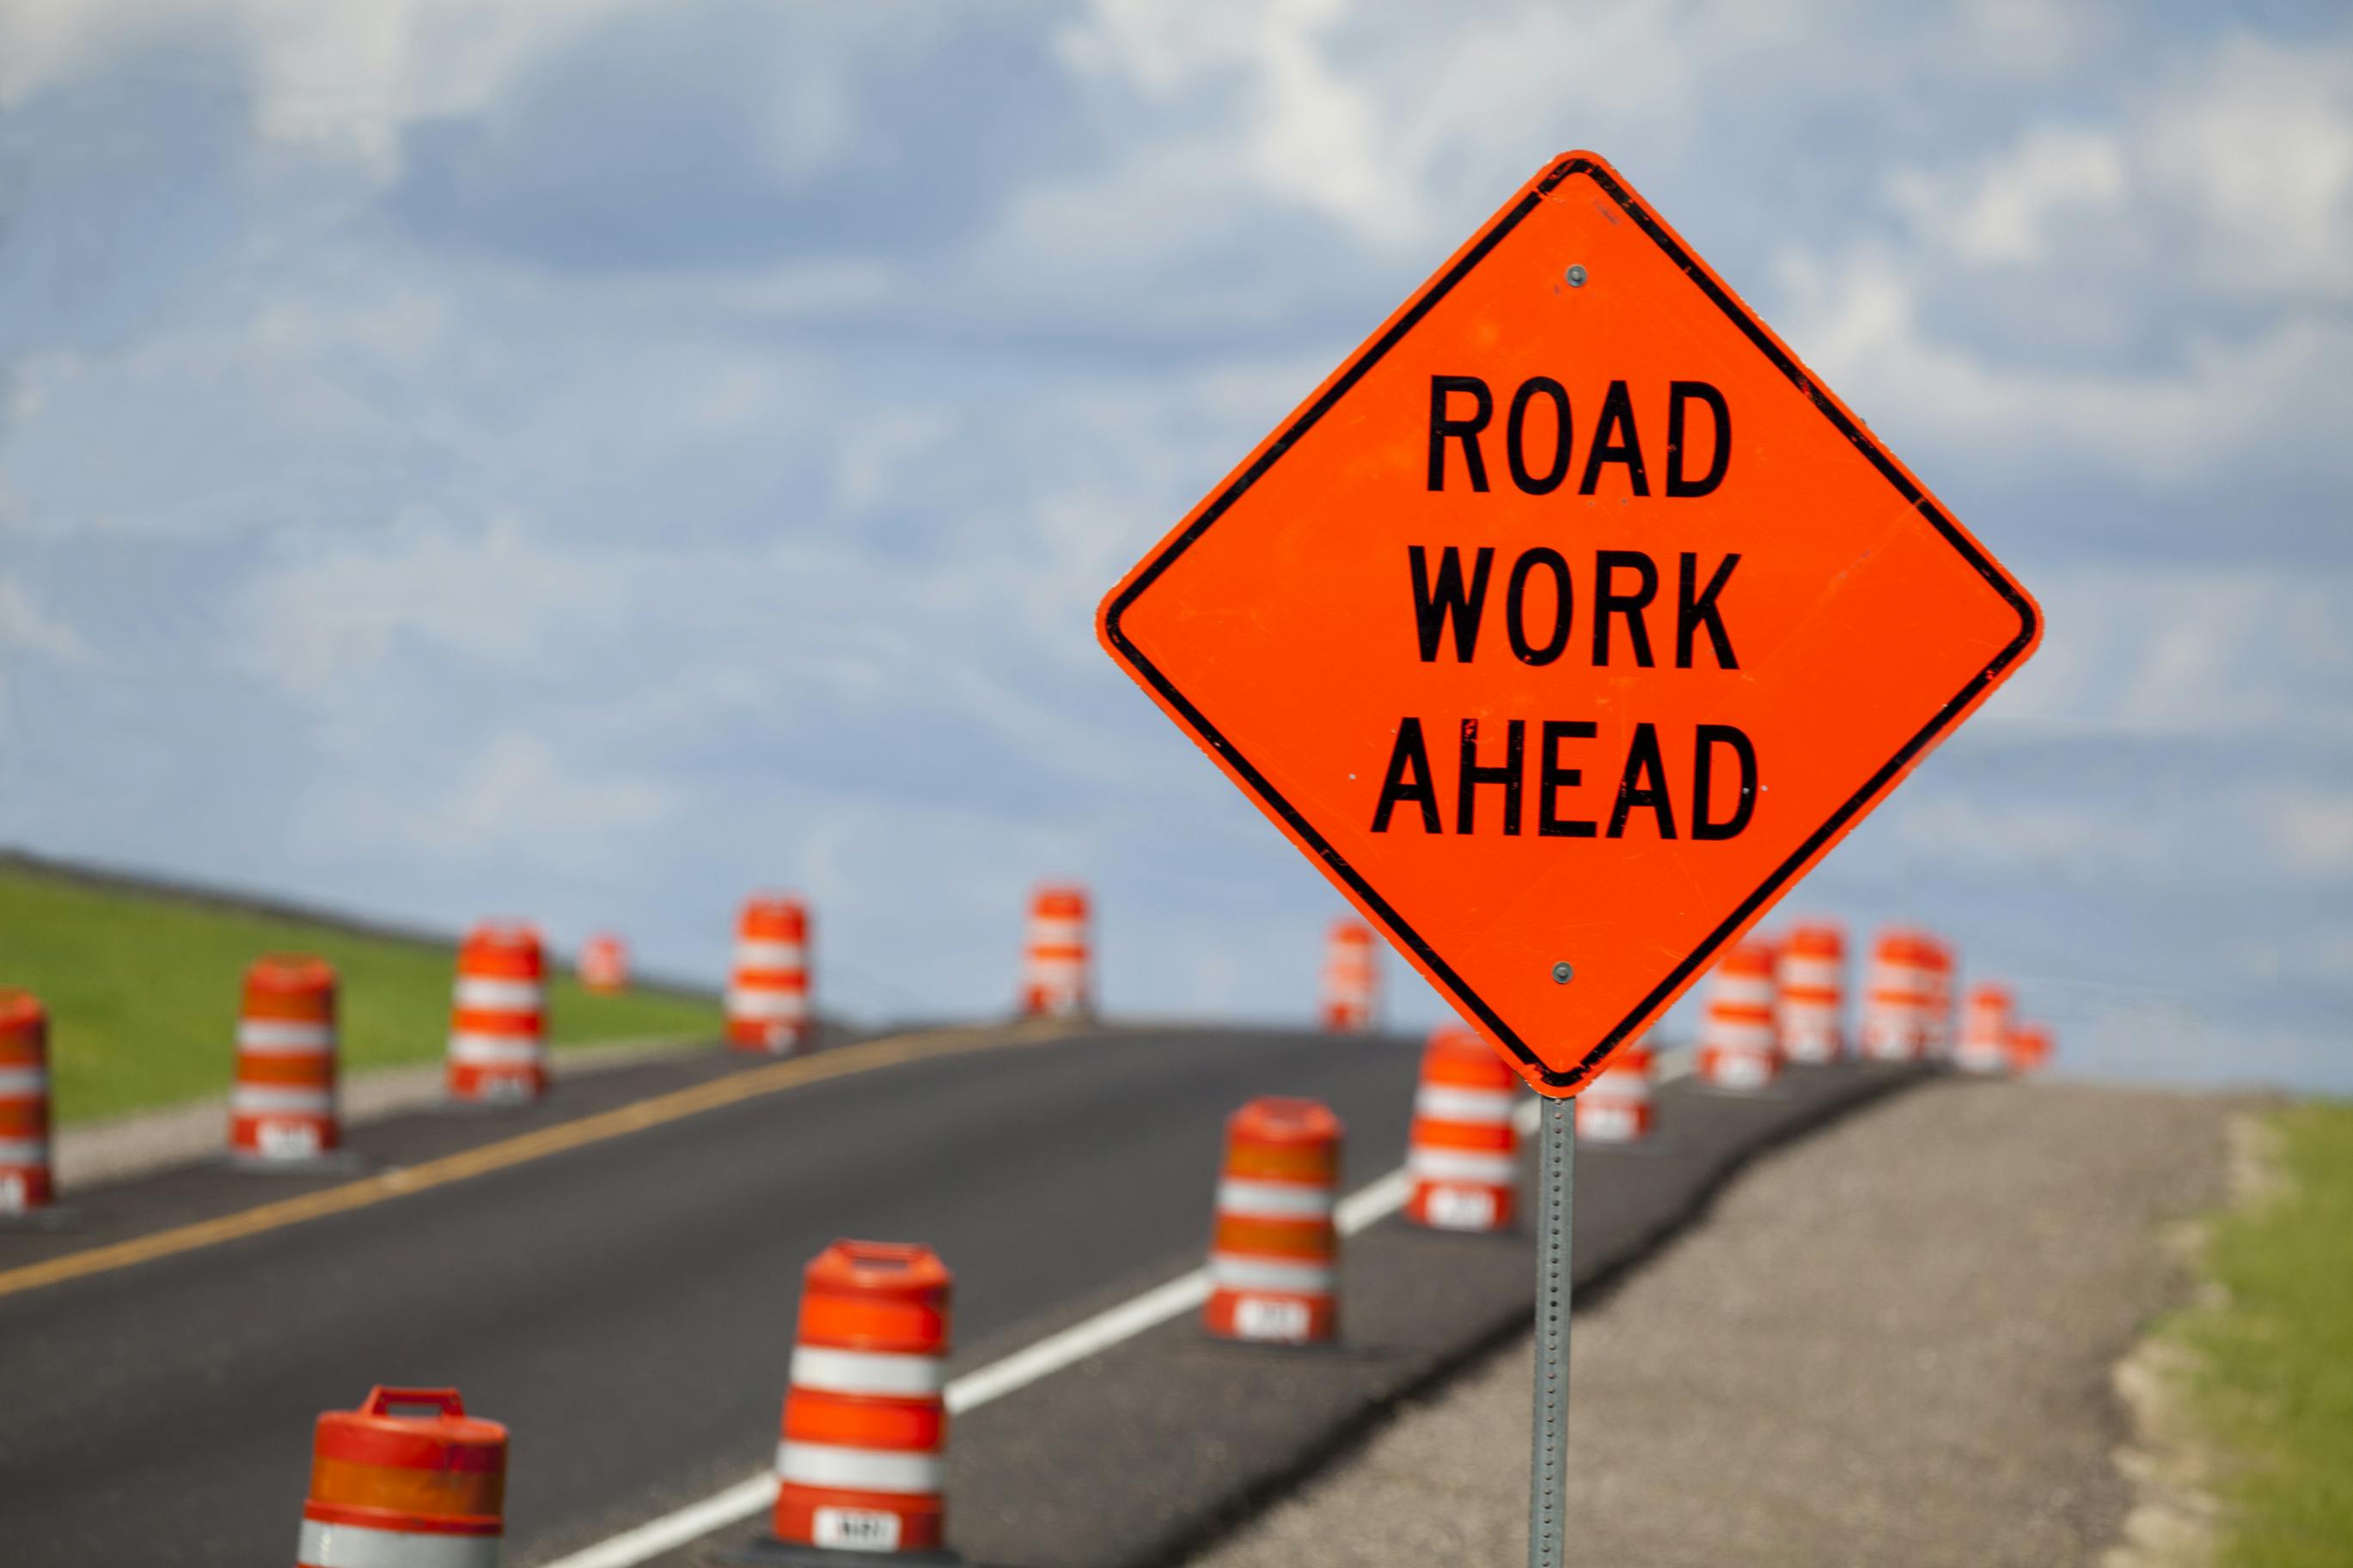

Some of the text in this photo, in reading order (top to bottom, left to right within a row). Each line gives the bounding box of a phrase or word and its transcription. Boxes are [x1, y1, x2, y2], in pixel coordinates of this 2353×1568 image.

[1427, 375, 1732, 498] ROAD
[1409, 546, 1740, 670] WORK
[1371, 717, 1758, 841] AHEAD
